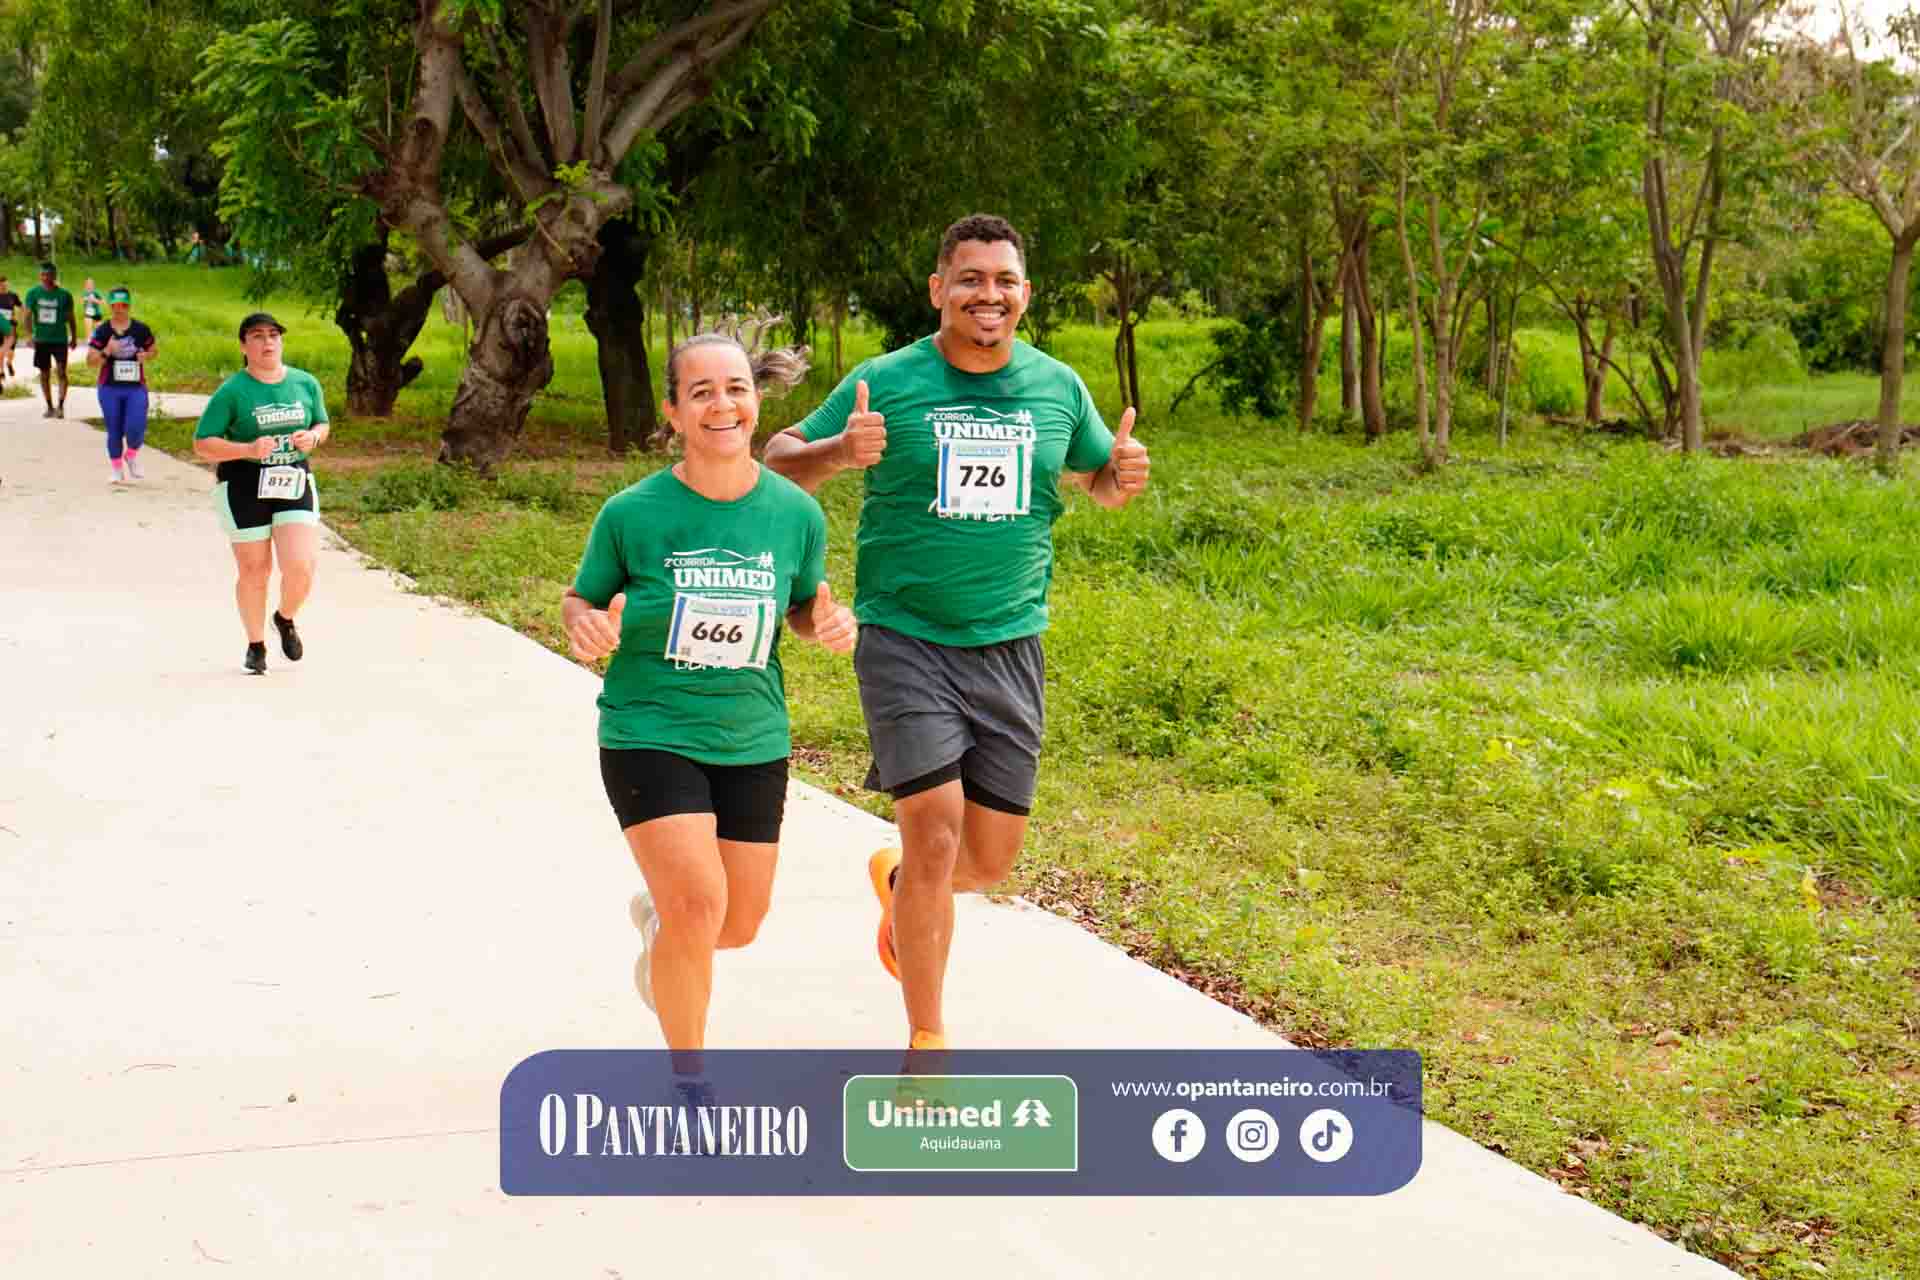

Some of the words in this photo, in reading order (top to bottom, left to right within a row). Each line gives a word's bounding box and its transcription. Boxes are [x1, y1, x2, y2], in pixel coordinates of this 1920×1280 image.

[933, 421, 1037, 441] UNIMED
[267, 476, 292, 487] 812
[959, 465, 1006, 487] 726
[673, 567, 776, 590] UNIMED
[691, 621, 743, 643] 666
